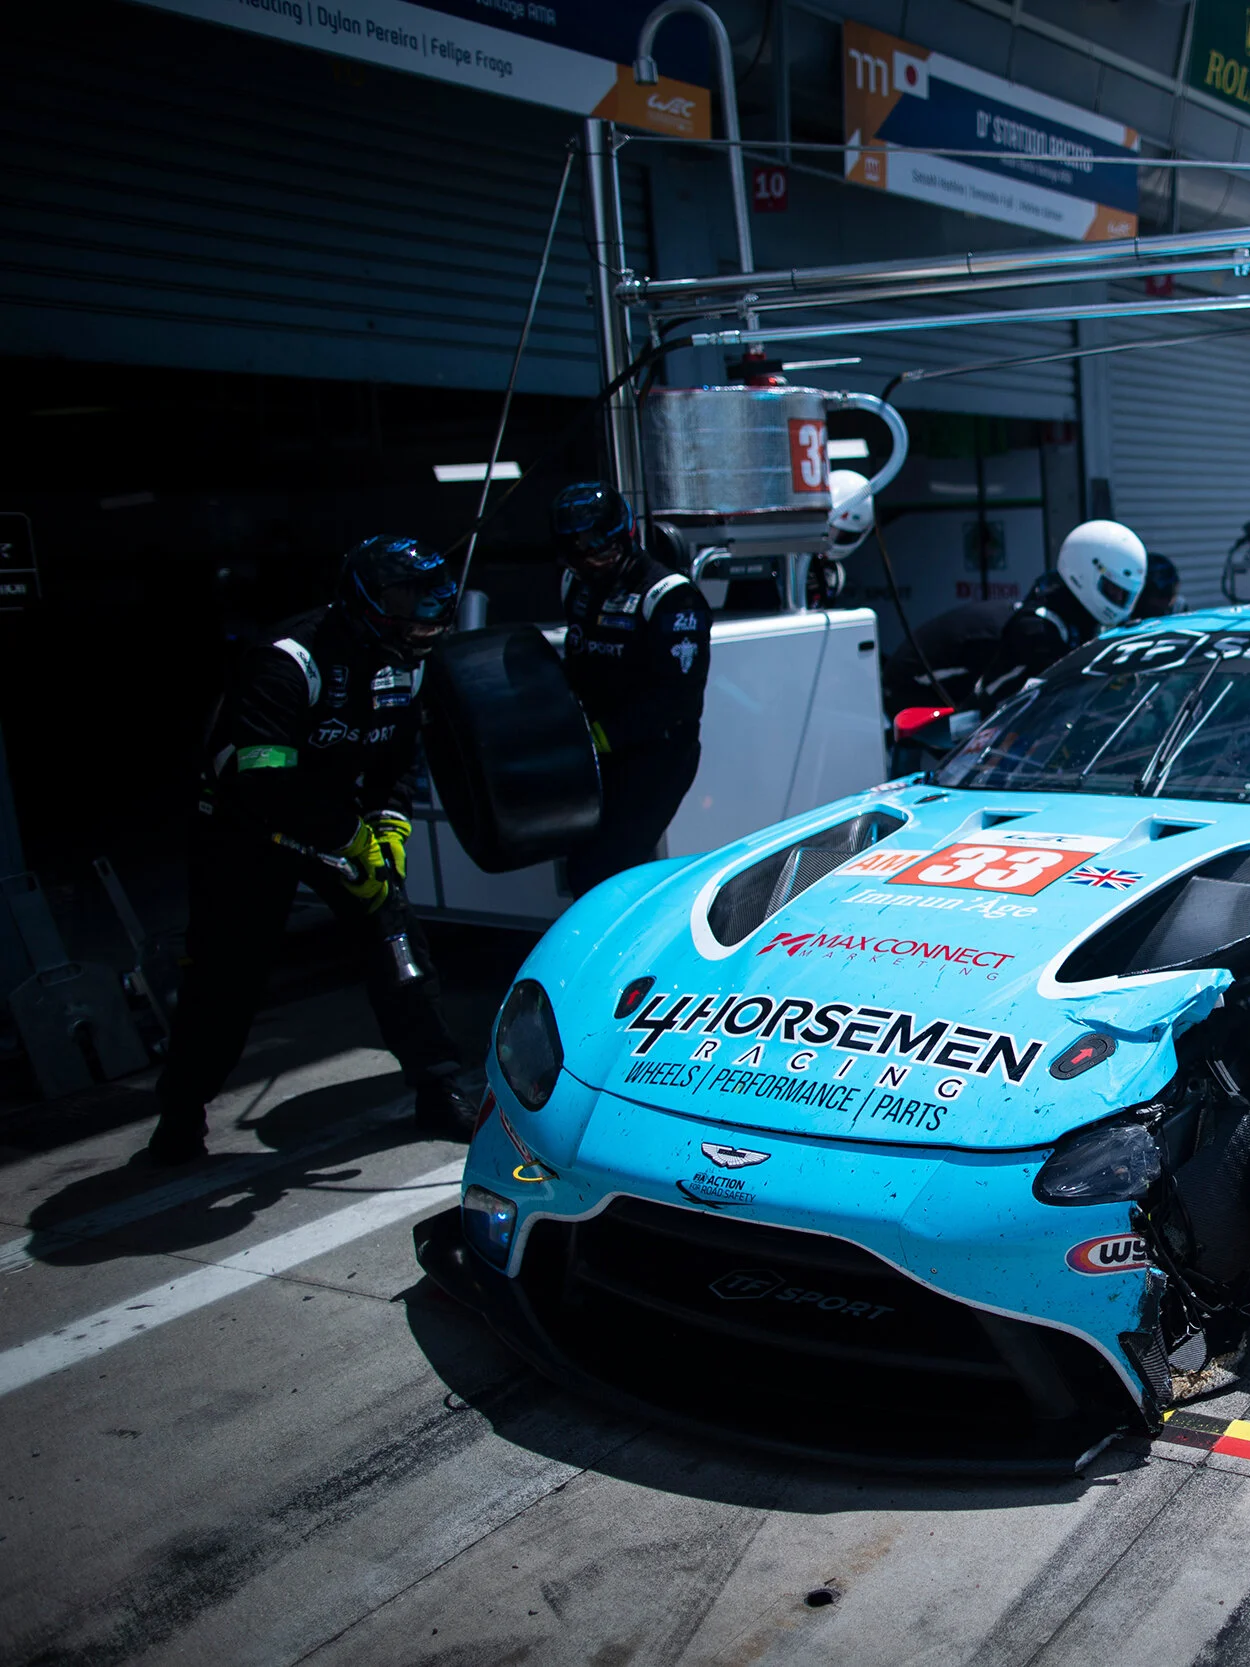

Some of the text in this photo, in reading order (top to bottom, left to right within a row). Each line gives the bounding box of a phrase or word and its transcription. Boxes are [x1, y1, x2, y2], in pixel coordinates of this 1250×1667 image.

[317, 5, 361, 34] Dylan
[367, 19, 418, 50] Pereira
[431, 38, 471, 65] Felipe
[475, 51, 513, 78] Fraga
[755, 172, 786, 199] 10
[1111, 638, 1189, 665] TF
[845, 846, 1064, 889] AM 33
[798, 949, 1000, 981] MARKETING
[810, 933, 1016, 969] MAX CONNECT
[694, 1040, 964, 1099] RACING
[625, 1060, 949, 1132] WHEELS PERFORMANCE PARTS
[700, 1184, 723, 1198] ROAD
[722, 1189, 756, 1203] SAFETY
[706, 1174, 746, 1191] ACTION
[727, 1273, 896, 1321] TF SPORT
